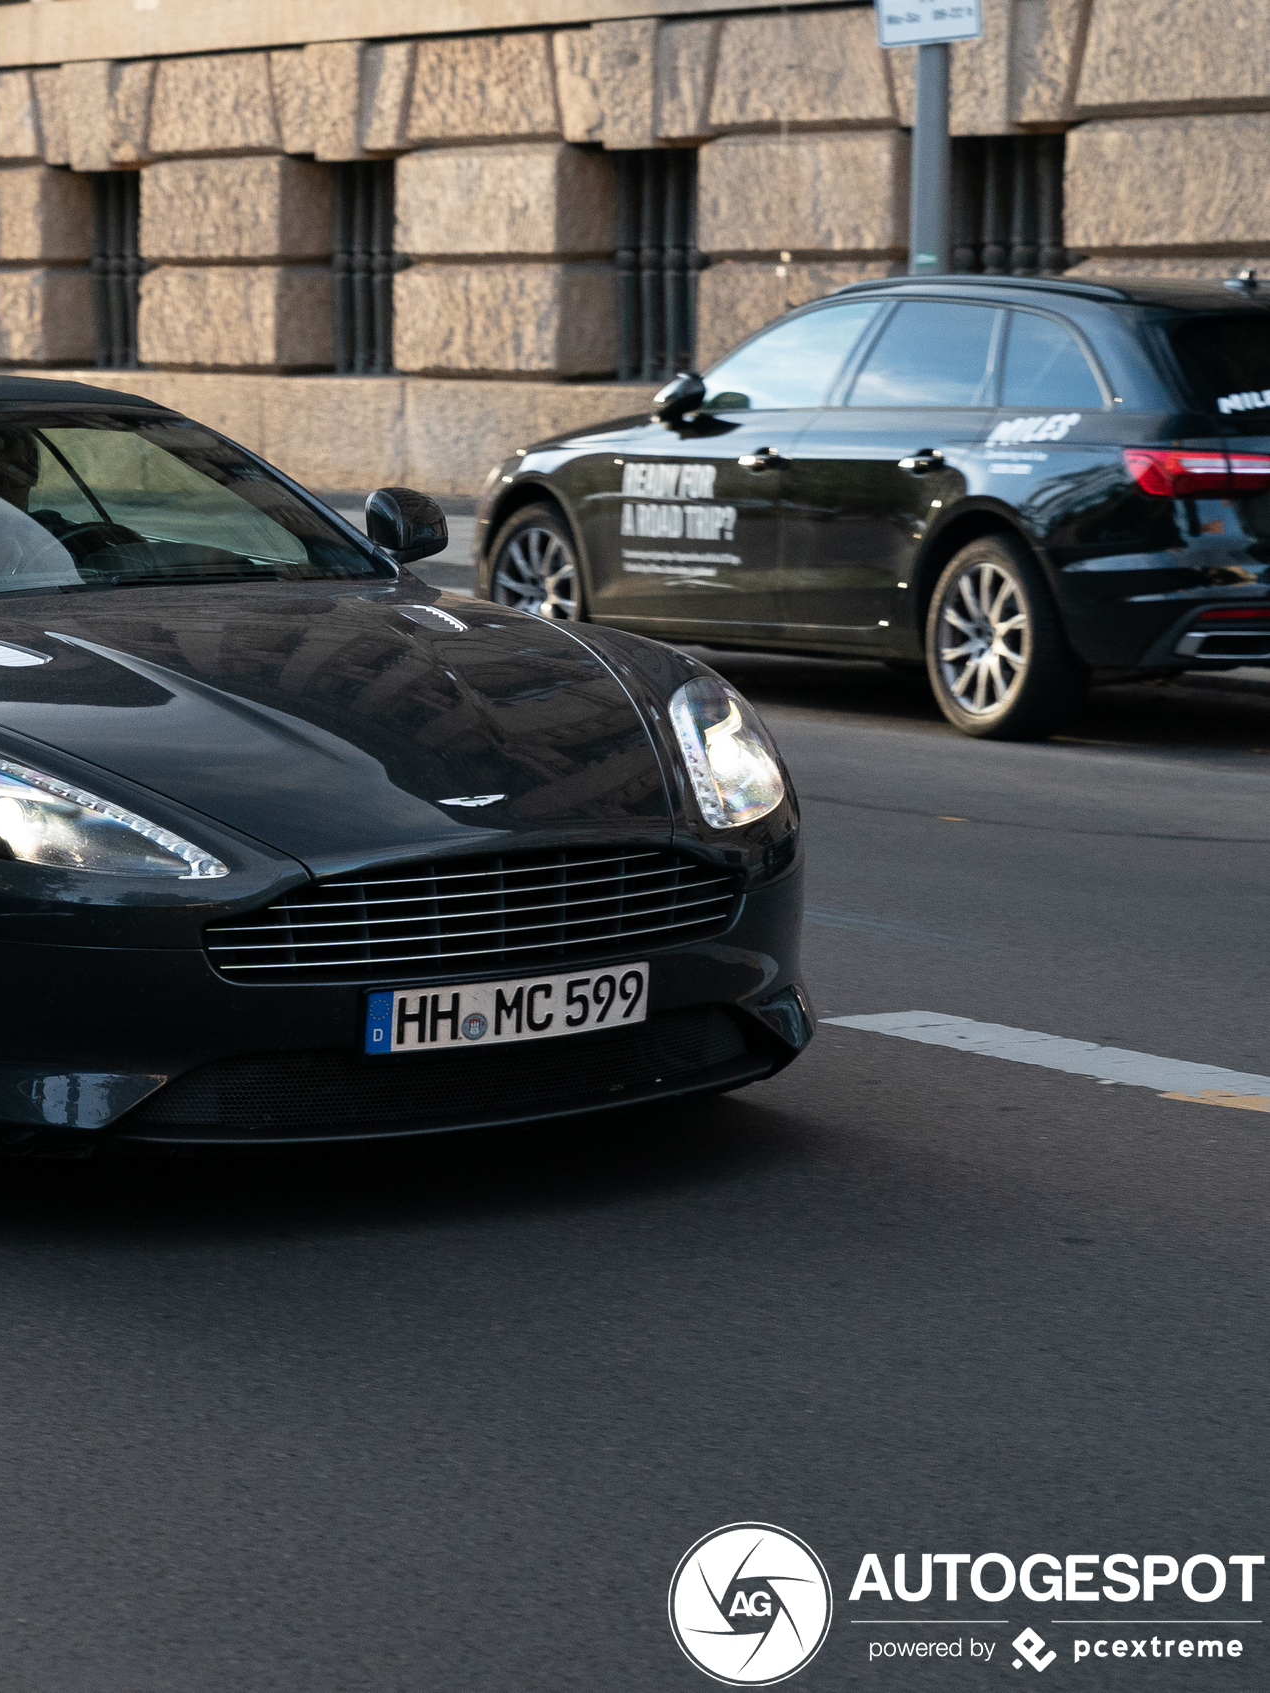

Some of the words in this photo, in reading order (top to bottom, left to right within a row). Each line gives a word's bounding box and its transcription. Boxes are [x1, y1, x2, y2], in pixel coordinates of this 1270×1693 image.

[396, 991, 460, 1045] HH
[494, 982, 554, 1036] MC
[565, 969, 644, 1027] 599
[373, 1028, 383, 1042] D
